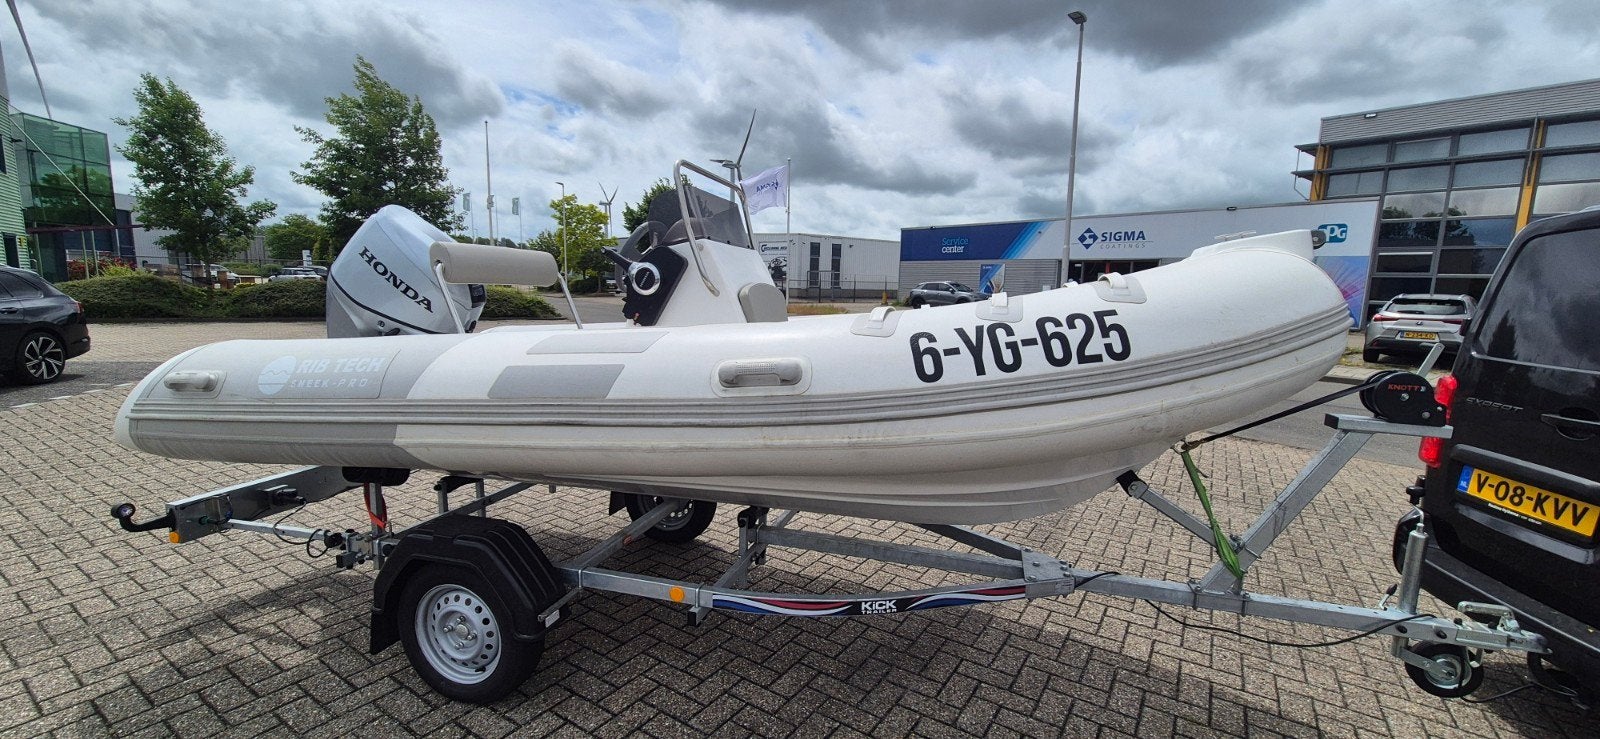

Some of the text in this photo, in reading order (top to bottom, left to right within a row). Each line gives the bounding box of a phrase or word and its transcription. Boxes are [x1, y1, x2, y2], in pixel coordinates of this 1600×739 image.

[942, 236, 969, 246] Service
[1101, 229, 1146, 242] SIGMA
[1319, 225, 1347, 241] PG
[942, 245, 964, 254] center
[358, 246, 434, 313] HONDA
[909, 309, 1132, 384] 6-YG-625
[296, 357, 386, 374] RIB TECH
[1387, 383, 1420, 391] KNOTT
[1475, 473, 1590, 527] V-08-KVV
